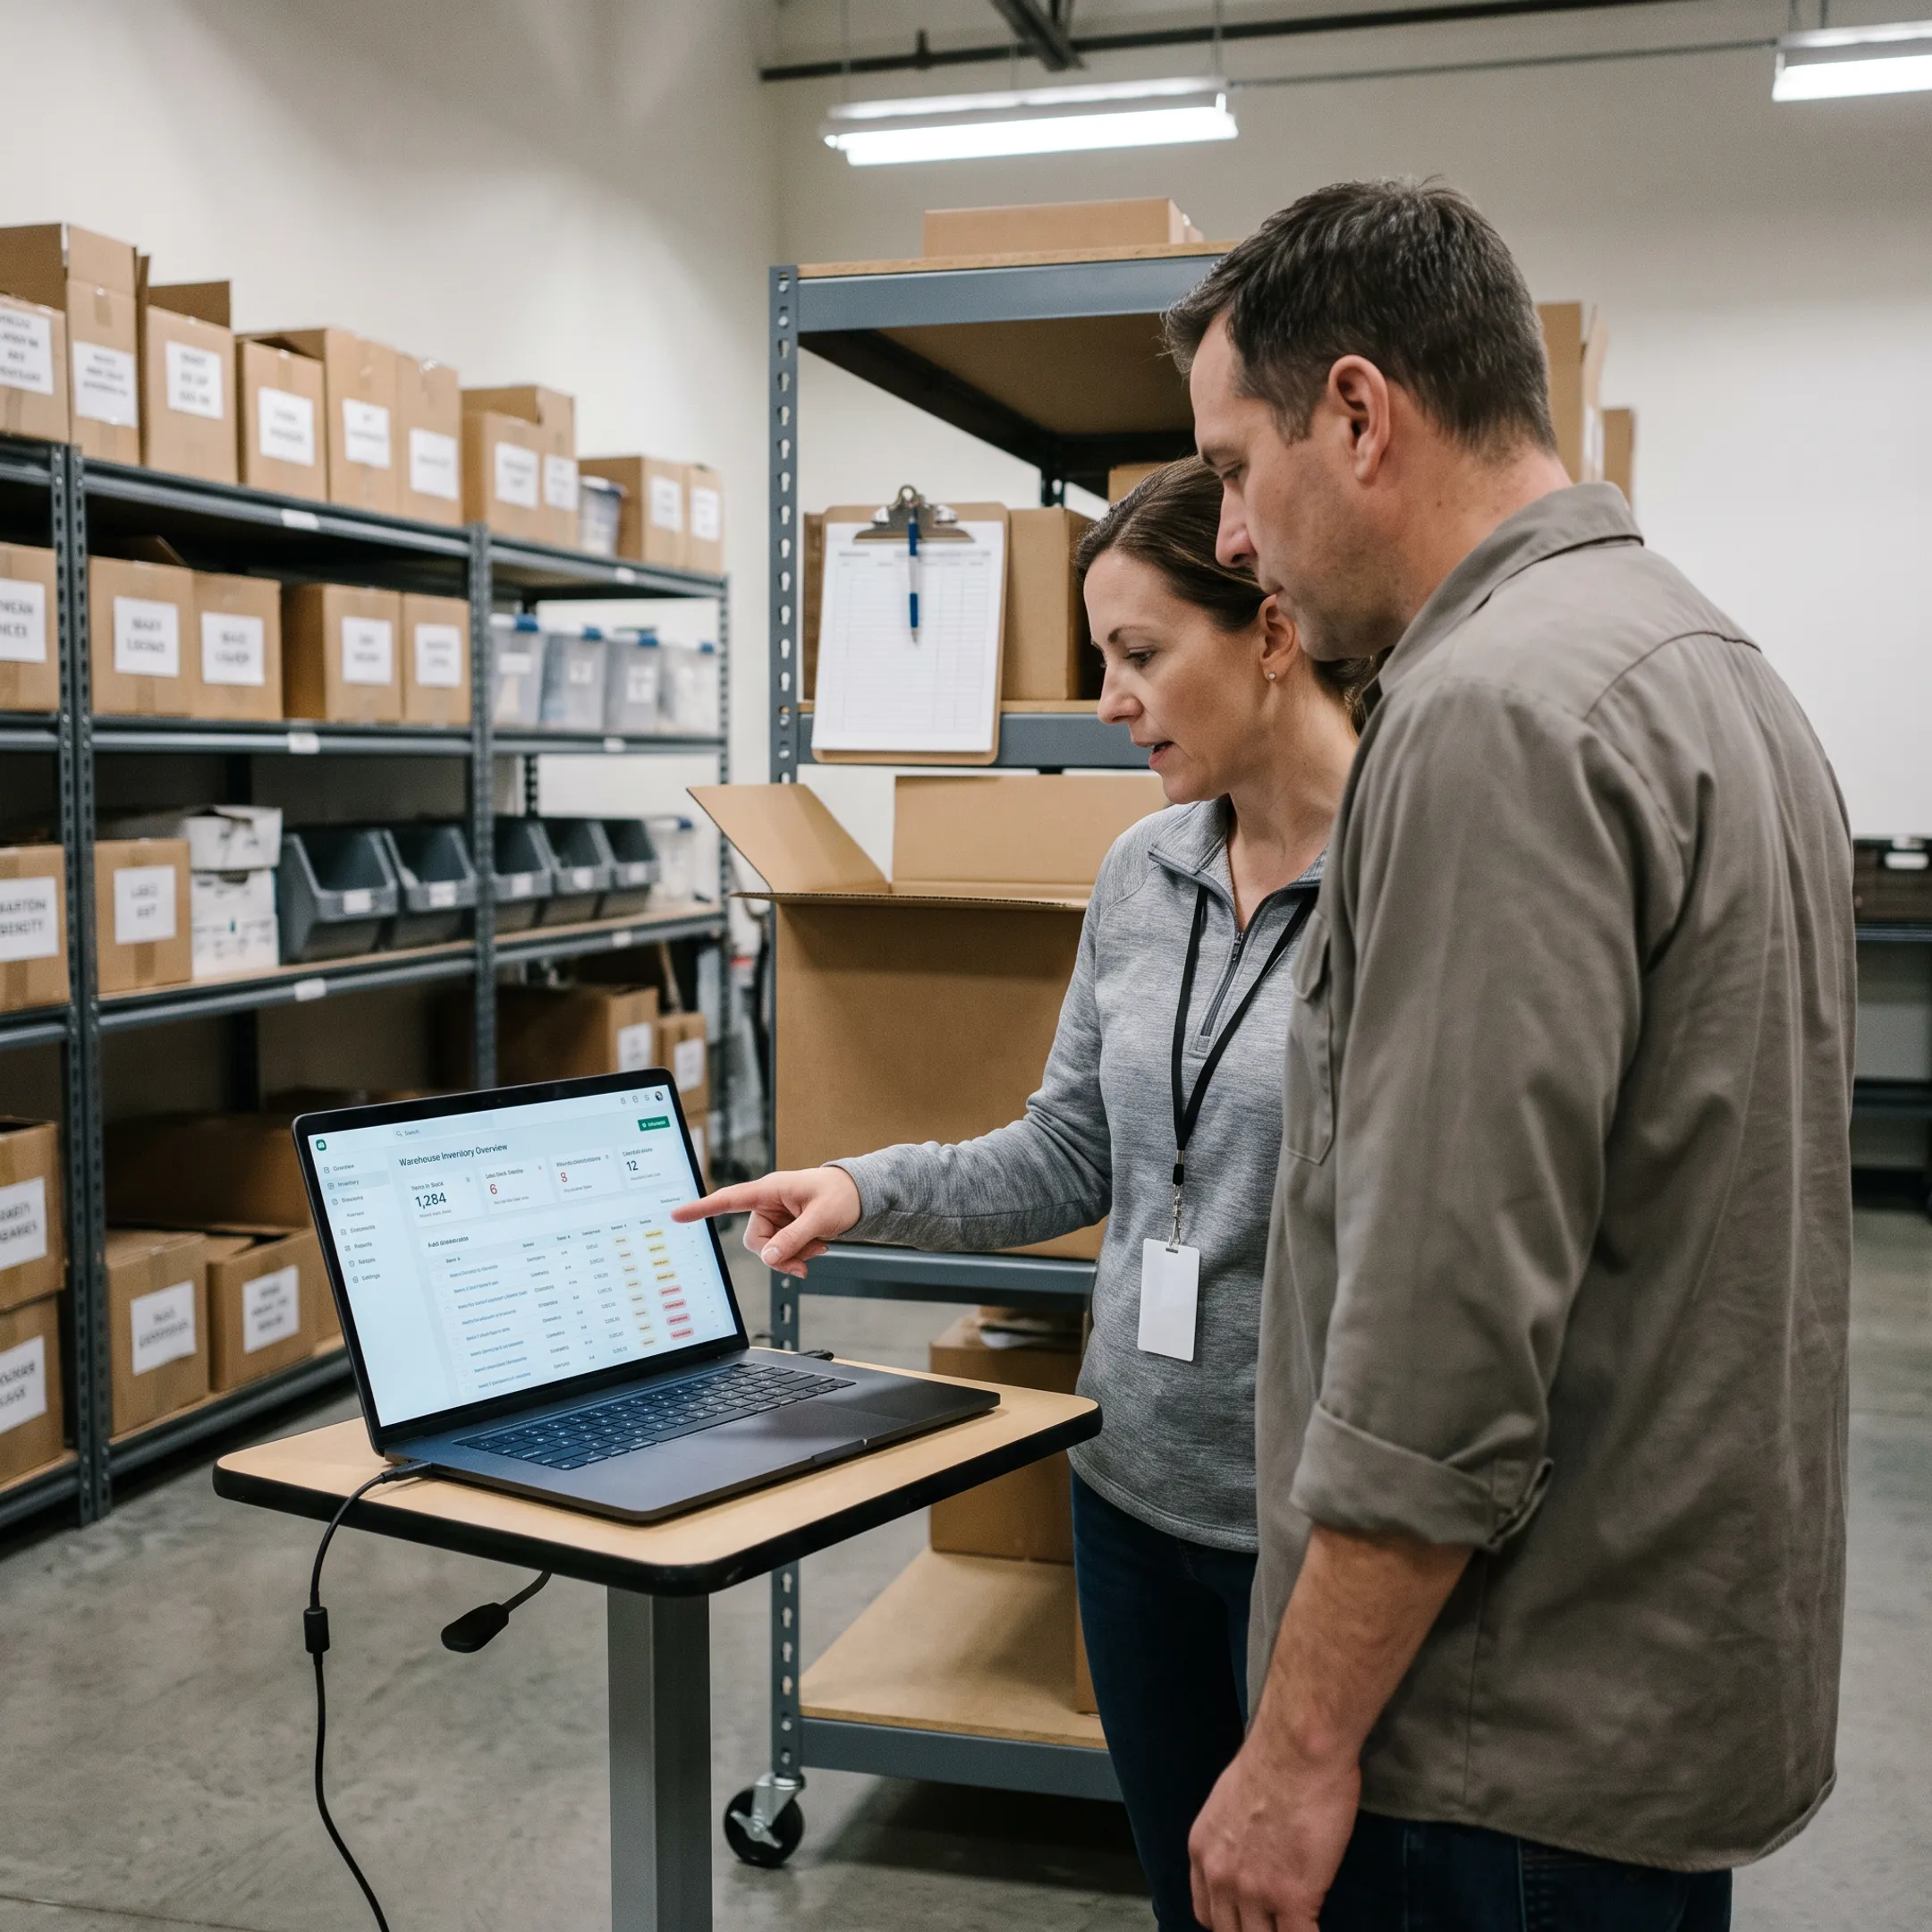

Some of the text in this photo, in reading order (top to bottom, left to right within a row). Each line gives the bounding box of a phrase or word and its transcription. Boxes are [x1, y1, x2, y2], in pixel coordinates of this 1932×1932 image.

[399, 1154, 440, 1166] Warehouse
[476, 1144, 507, 1155] Overview
[626, 1160, 639, 1172] 12
[489, 1183, 497, 1195] 6
[415, 1192, 446, 1209] 1,284
